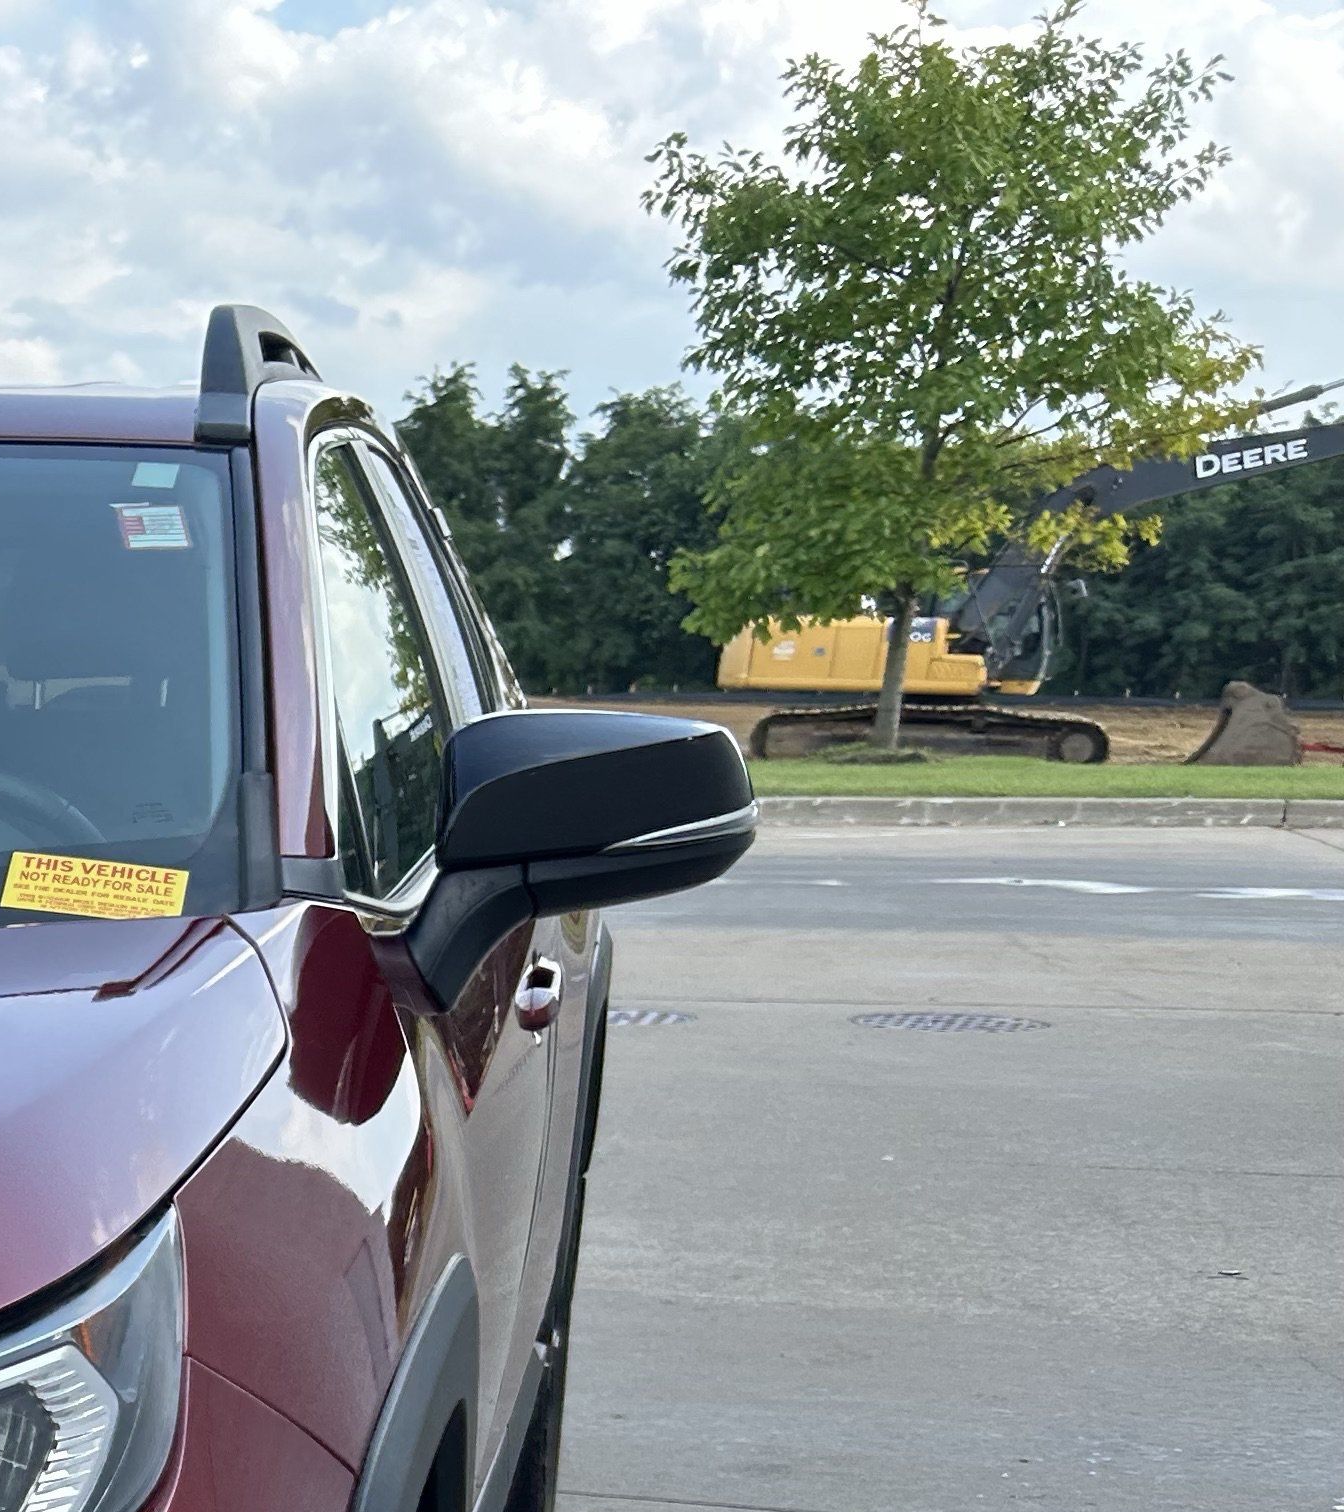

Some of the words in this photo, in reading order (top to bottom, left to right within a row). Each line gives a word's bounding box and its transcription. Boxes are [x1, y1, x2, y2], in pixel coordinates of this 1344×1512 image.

[1195, 438, 1309, 479] DEERE
[19, 870, 49, 883] NOT
[52, 873, 101, 888] READY
[103, 879, 133, 893] FOR
[135, 883, 174, 898] SALE
[23, 855, 74, 873] THIS
[81, 862, 178, 885] VEHICLE
[53, 887, 88, 896] DEALER
